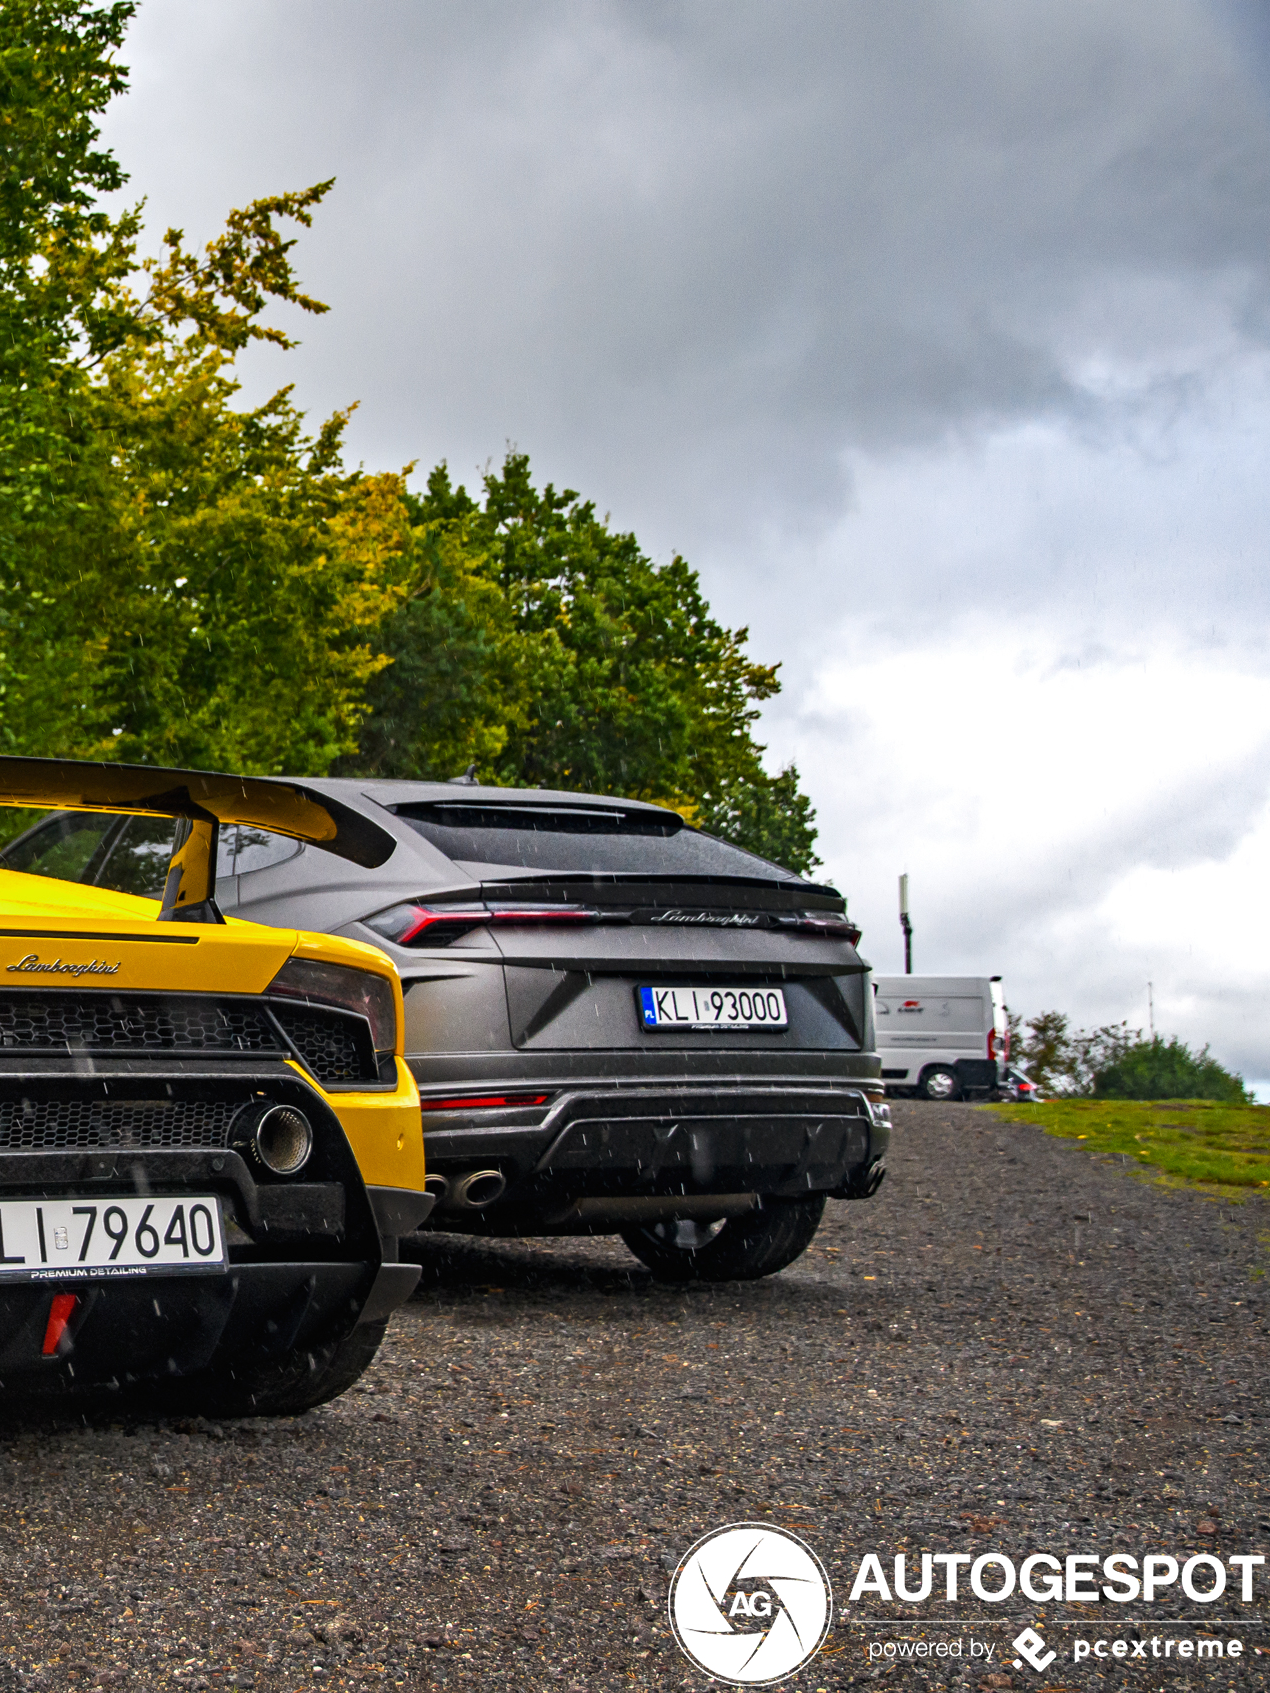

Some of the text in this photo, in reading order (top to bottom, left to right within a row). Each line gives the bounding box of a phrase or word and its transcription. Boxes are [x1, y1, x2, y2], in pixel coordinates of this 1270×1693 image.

[650, 909, 759, 925] Lamborghini
[6, 953, 121, 977] Lamborghini
[644, 1010, 654, 1019] PL
[655, 990, 781, 1021] KLI 93000
[71, 1203, 216, 1262] 79640
[30, 1266, 147, 1279] PREMIUM DETAILING
